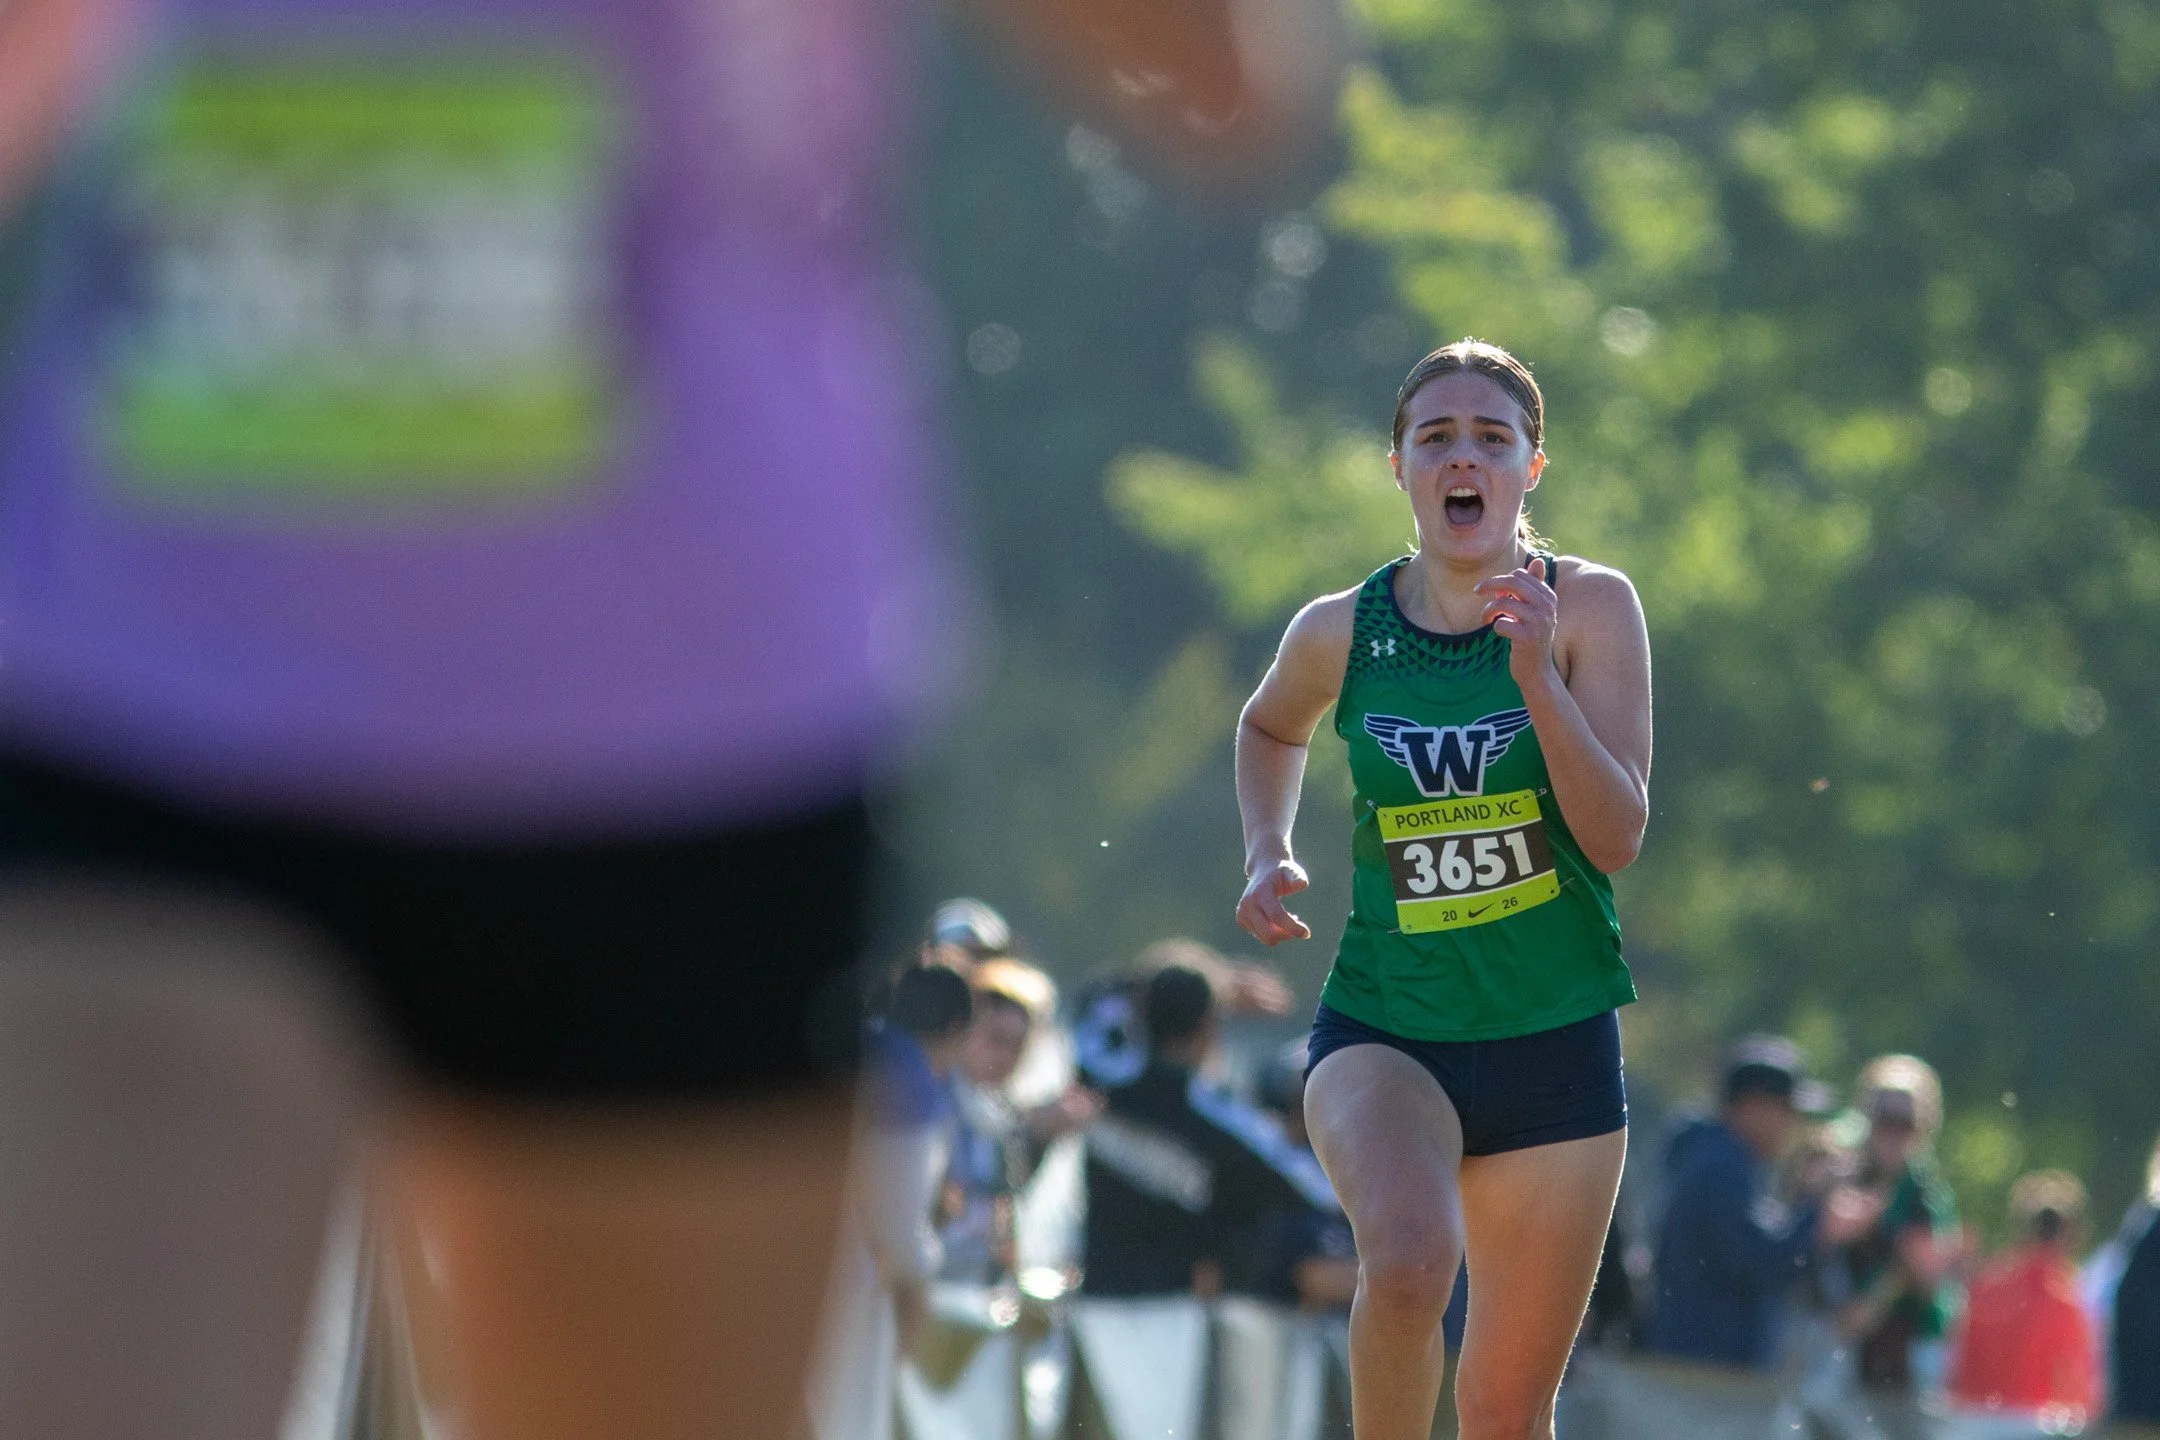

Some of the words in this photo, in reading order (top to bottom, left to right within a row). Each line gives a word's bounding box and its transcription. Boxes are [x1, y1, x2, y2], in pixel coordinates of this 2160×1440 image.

[1395, 725, 1495, 797] W
[1395, 804, 1490, 829] PORTLAND
[1498, 800, 1521, 817] XC
[1403, 830, 1533, 894] 3651
[1442, 910, 1457, 922] 20
[1502, 897, 1518, 910] 26
